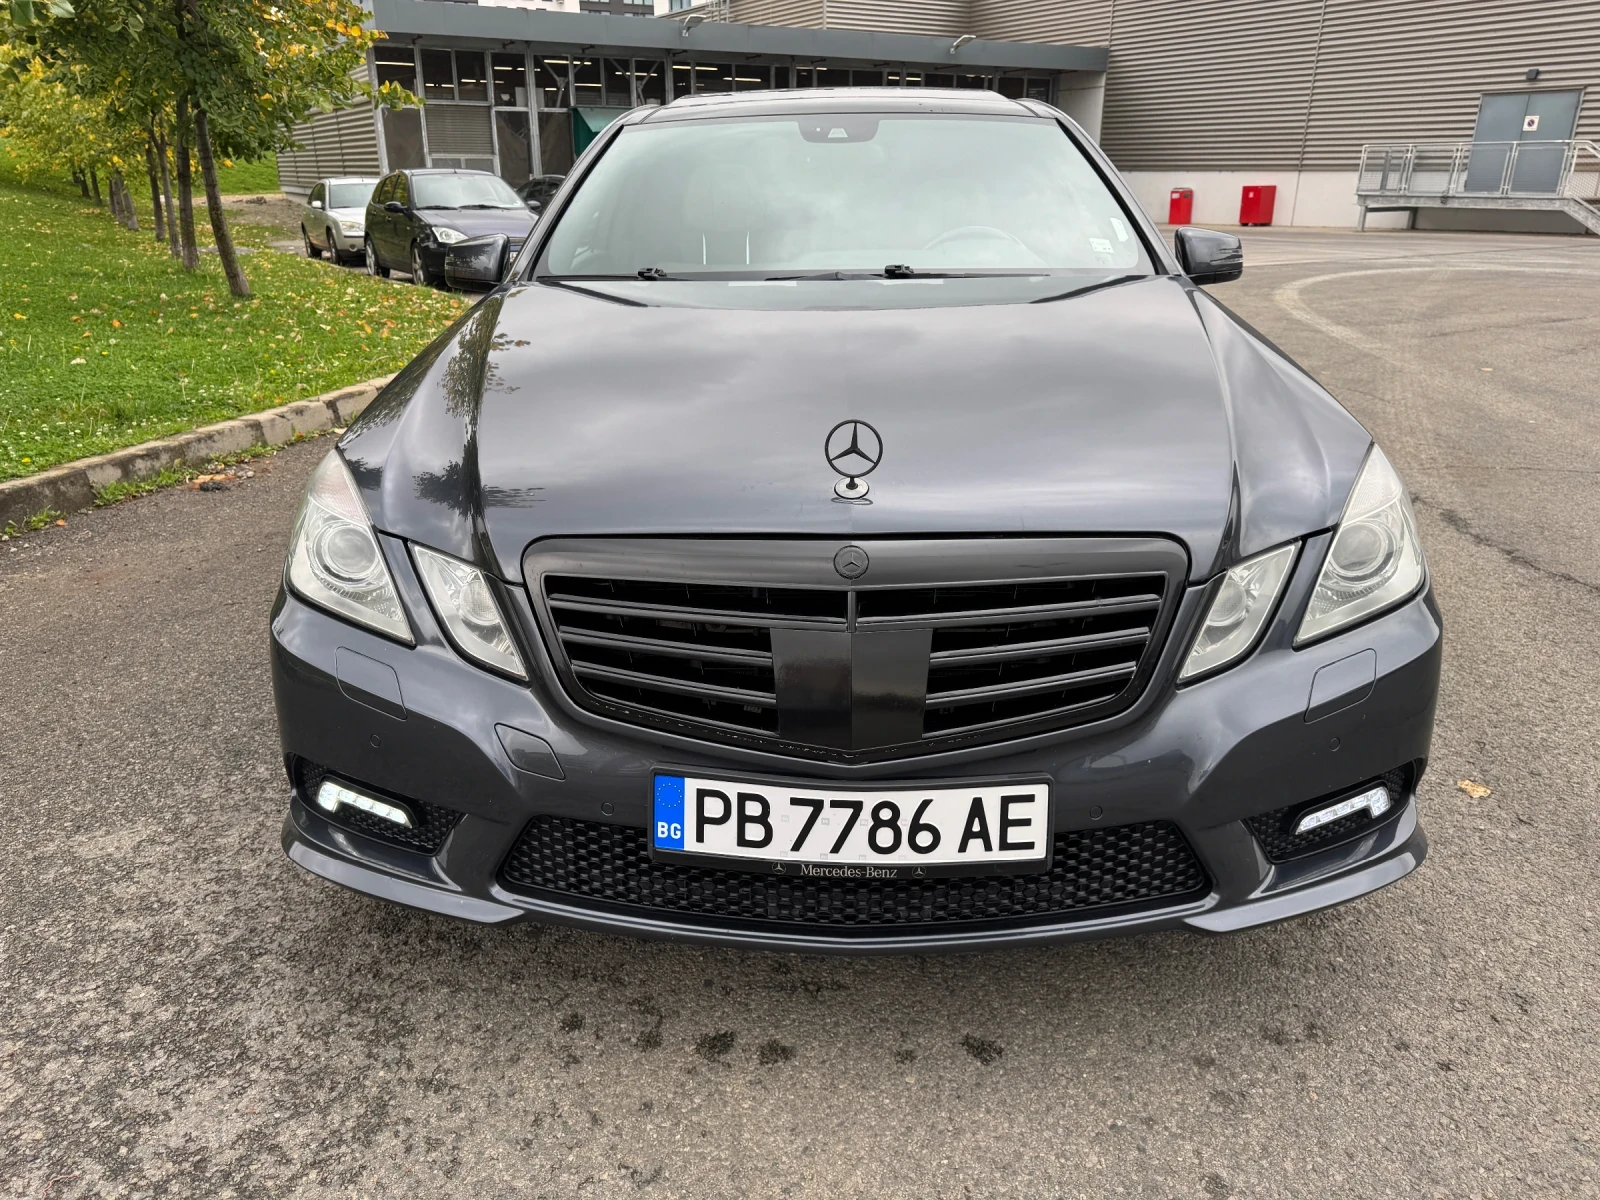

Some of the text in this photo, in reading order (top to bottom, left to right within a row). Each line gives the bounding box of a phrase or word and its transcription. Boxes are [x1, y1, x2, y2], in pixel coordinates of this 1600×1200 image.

[657, 821, 682, 840] BG
[696, 788, 1036, 855] PB 7786 AE
[800, 864, 898, 879] Mercedes-Benz
